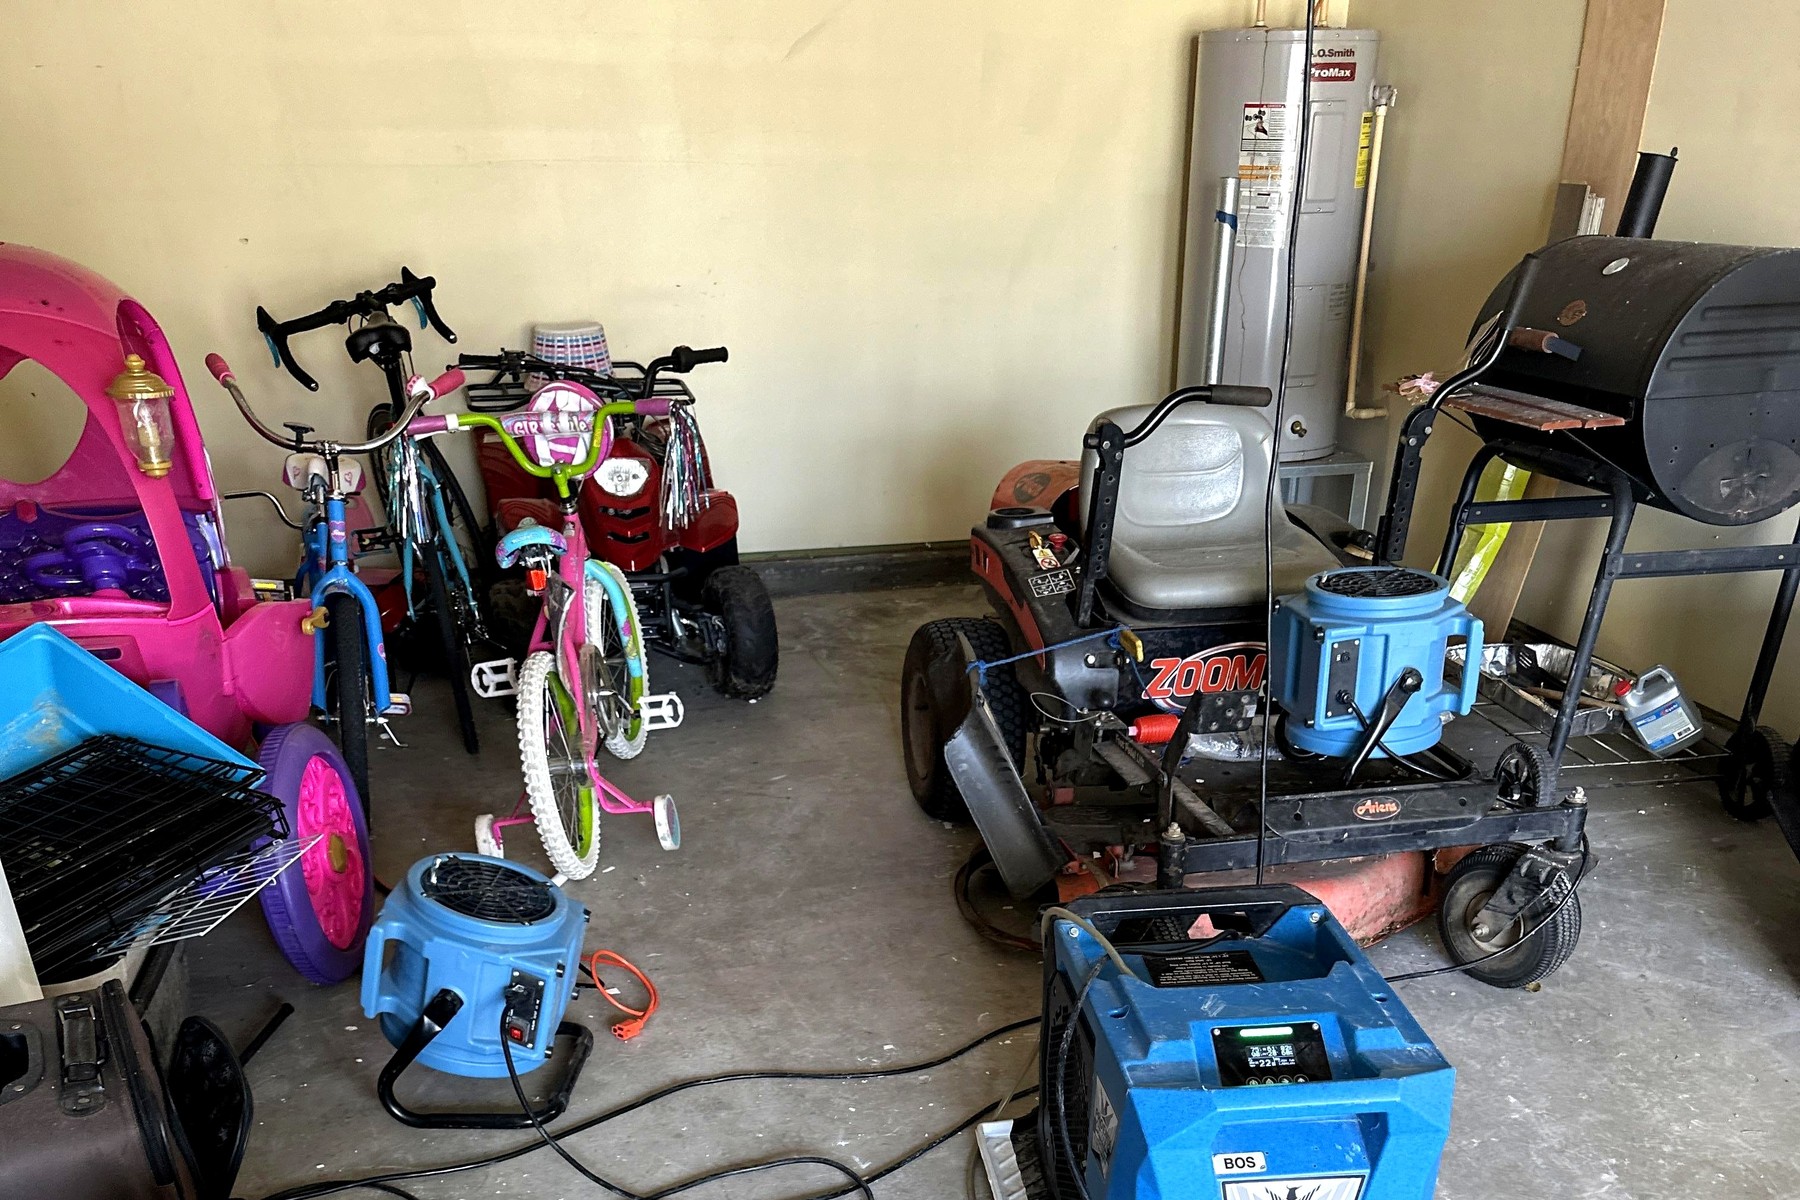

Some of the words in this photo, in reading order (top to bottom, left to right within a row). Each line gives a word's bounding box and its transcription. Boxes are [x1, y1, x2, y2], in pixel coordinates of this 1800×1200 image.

[1142, 654, 1267, 699] ZOOM
[1357, 799, 1398, 815] Ariens
[1224, 1157, 1256, 1169] BOS
